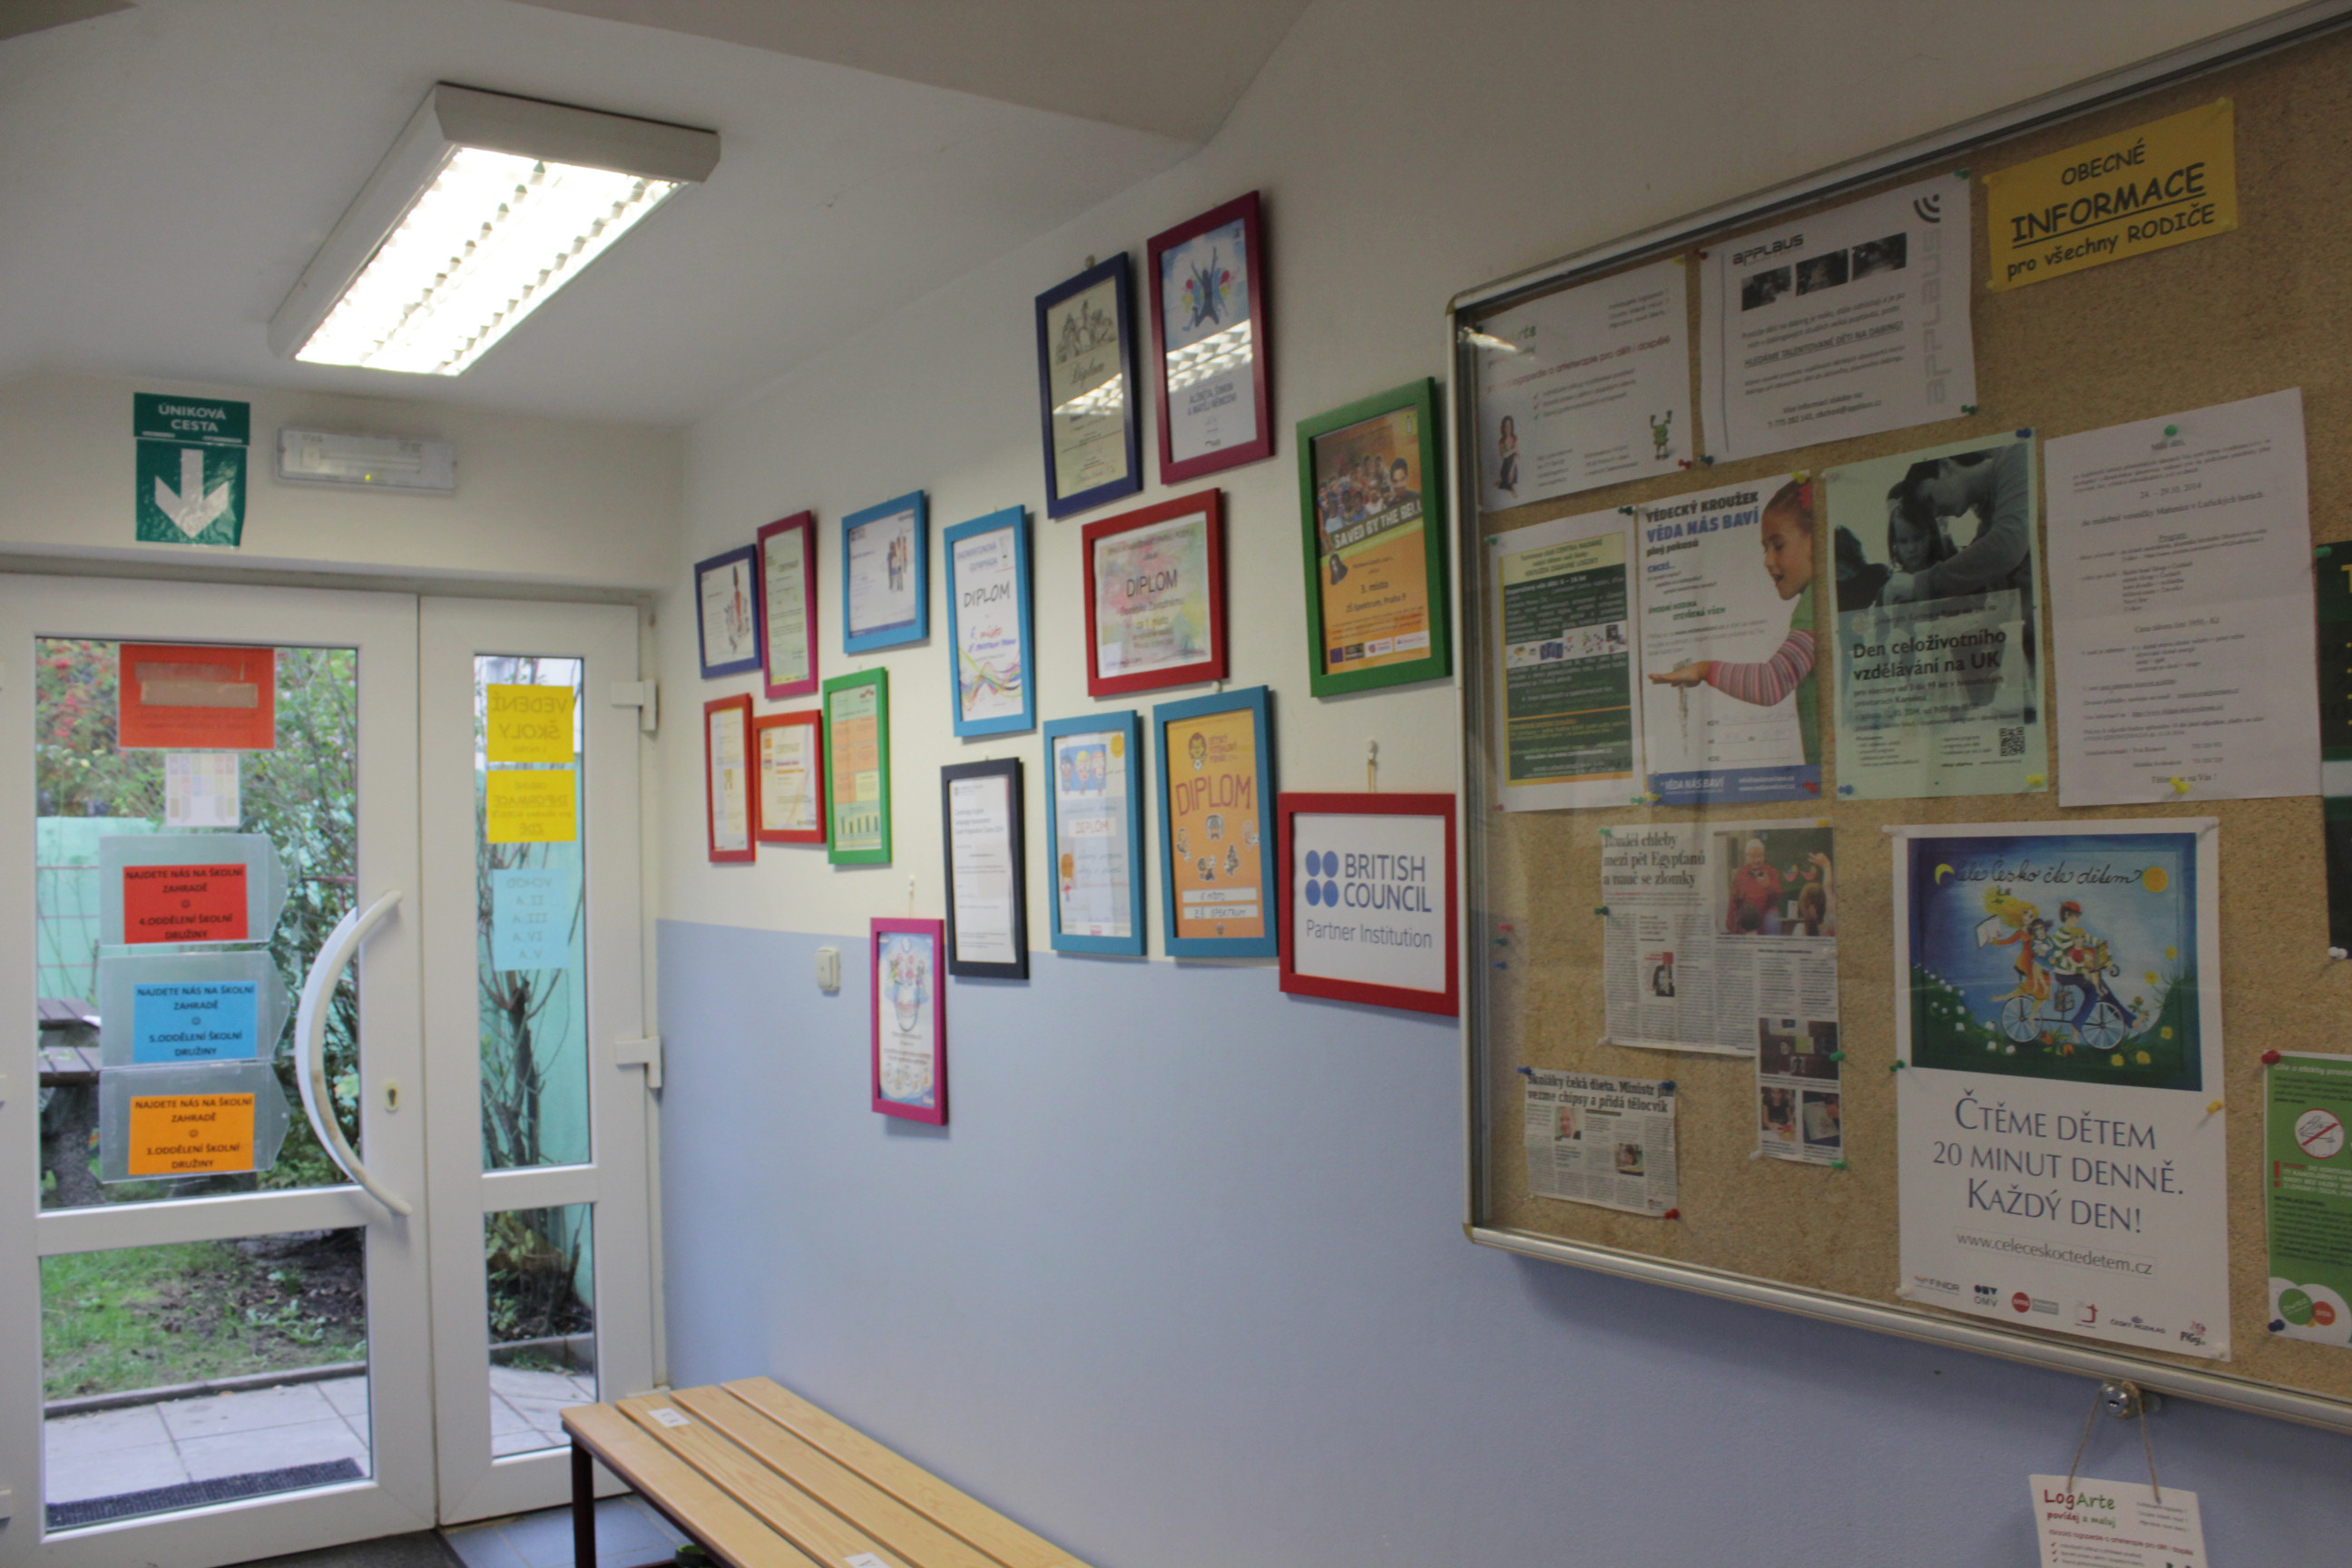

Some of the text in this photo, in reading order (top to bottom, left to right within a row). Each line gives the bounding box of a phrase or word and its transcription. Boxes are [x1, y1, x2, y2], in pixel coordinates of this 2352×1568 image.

[2061, 138, 2146, 185] OBECNÉ
[2010, 162, 2206, 244] INFORMACE
[2006, 202, 2216, 282] pro všechny RODIČE
[158, 402, 227, 420] ÚNIKOVÁ
[171, 418, 219, 432] CESTA
[1646, 491, 1759, 523] VĚDECKÝ KROUŽEK
[1333, 524, 1365, 550] SAVED
[1366, 517, 1378, 536] BY
[1379, 508, 1399, 527] THE
[1646, 505, 1760, 544] VĚDA NÁS BAVÍ
[1126, 569, 1178, 597] DIPLOM
[964, 581, 1011, 608] DIPLOM
[1853, 628, 2007, 659] Den celoživotního
[1853, 651, 2001, 681] vzdělávání na UK
[1684, 777, 1702, 789] NÁS
[1175, 773, 1252, 816] DIPLOM
[1641, 831, 1679, 849] chleby
[1344, 852, 1426, 882] BRITISH
[1603, 848, 1706, 869] mezi pět Egypťanů
[125, 867, 243, 879] NAJDETE NÁS NA ŠKOLNÍ
[1603, 869, 1699, 889] a nauč se zlomky
[162, 883, 208, 894] ZAHRADĚ
[1343, 881, 1433, 913] COUNCIL
[199, 913, 233, 924] ŠKOLNÍ
[164, 930, 208, 940] DRUŽINY
[1306, 918, 1433, 949] Partner Institution
[137, 984, 255, 996] NAJDETE NÁS NA ŠKOLNÍ
[173, 1000, 219, 1011] ZAHRADĚ
[208, 1030, 243, 1041] ŠKOLNÍ
[174, 1047, 217, 1057] DRUŽINY
[1565, 1075, 1588, 1090] čeká
[1590, 1078, 1618, 1093] dieta.
[1619, 1081, 1655, 1096] Ministr
[135, 1096, 252, 1109] NAJDETE NÁS NA ŠKOLNÍ
[1527, 1090, 1669, 1113] vezme chipsy a přidá tělocvik
[171, 1112, 216, 1123] ZAHRADĚ
[1955, 1088, 2157, 1150] ČTĚME DĚTEM
[205, 1142, 240, 1153] ŠKOLNÍ
[171, 1160, 214, 1170] DRUŽINY
[1932, 1141, 2185, 1195] 20 MINUT DENNĚ.
[1966, 1178, 2142, 1234] KAŽDÝ DEN!
[1955, 1233, 2154, 1276] www.celeceskoctedetem.cz
[1974, 1295, 1999, 1308] OMV
[2043, 1488, 2115, 1511] LogArte
[2046, 1511, 2081, 1525] povídej
